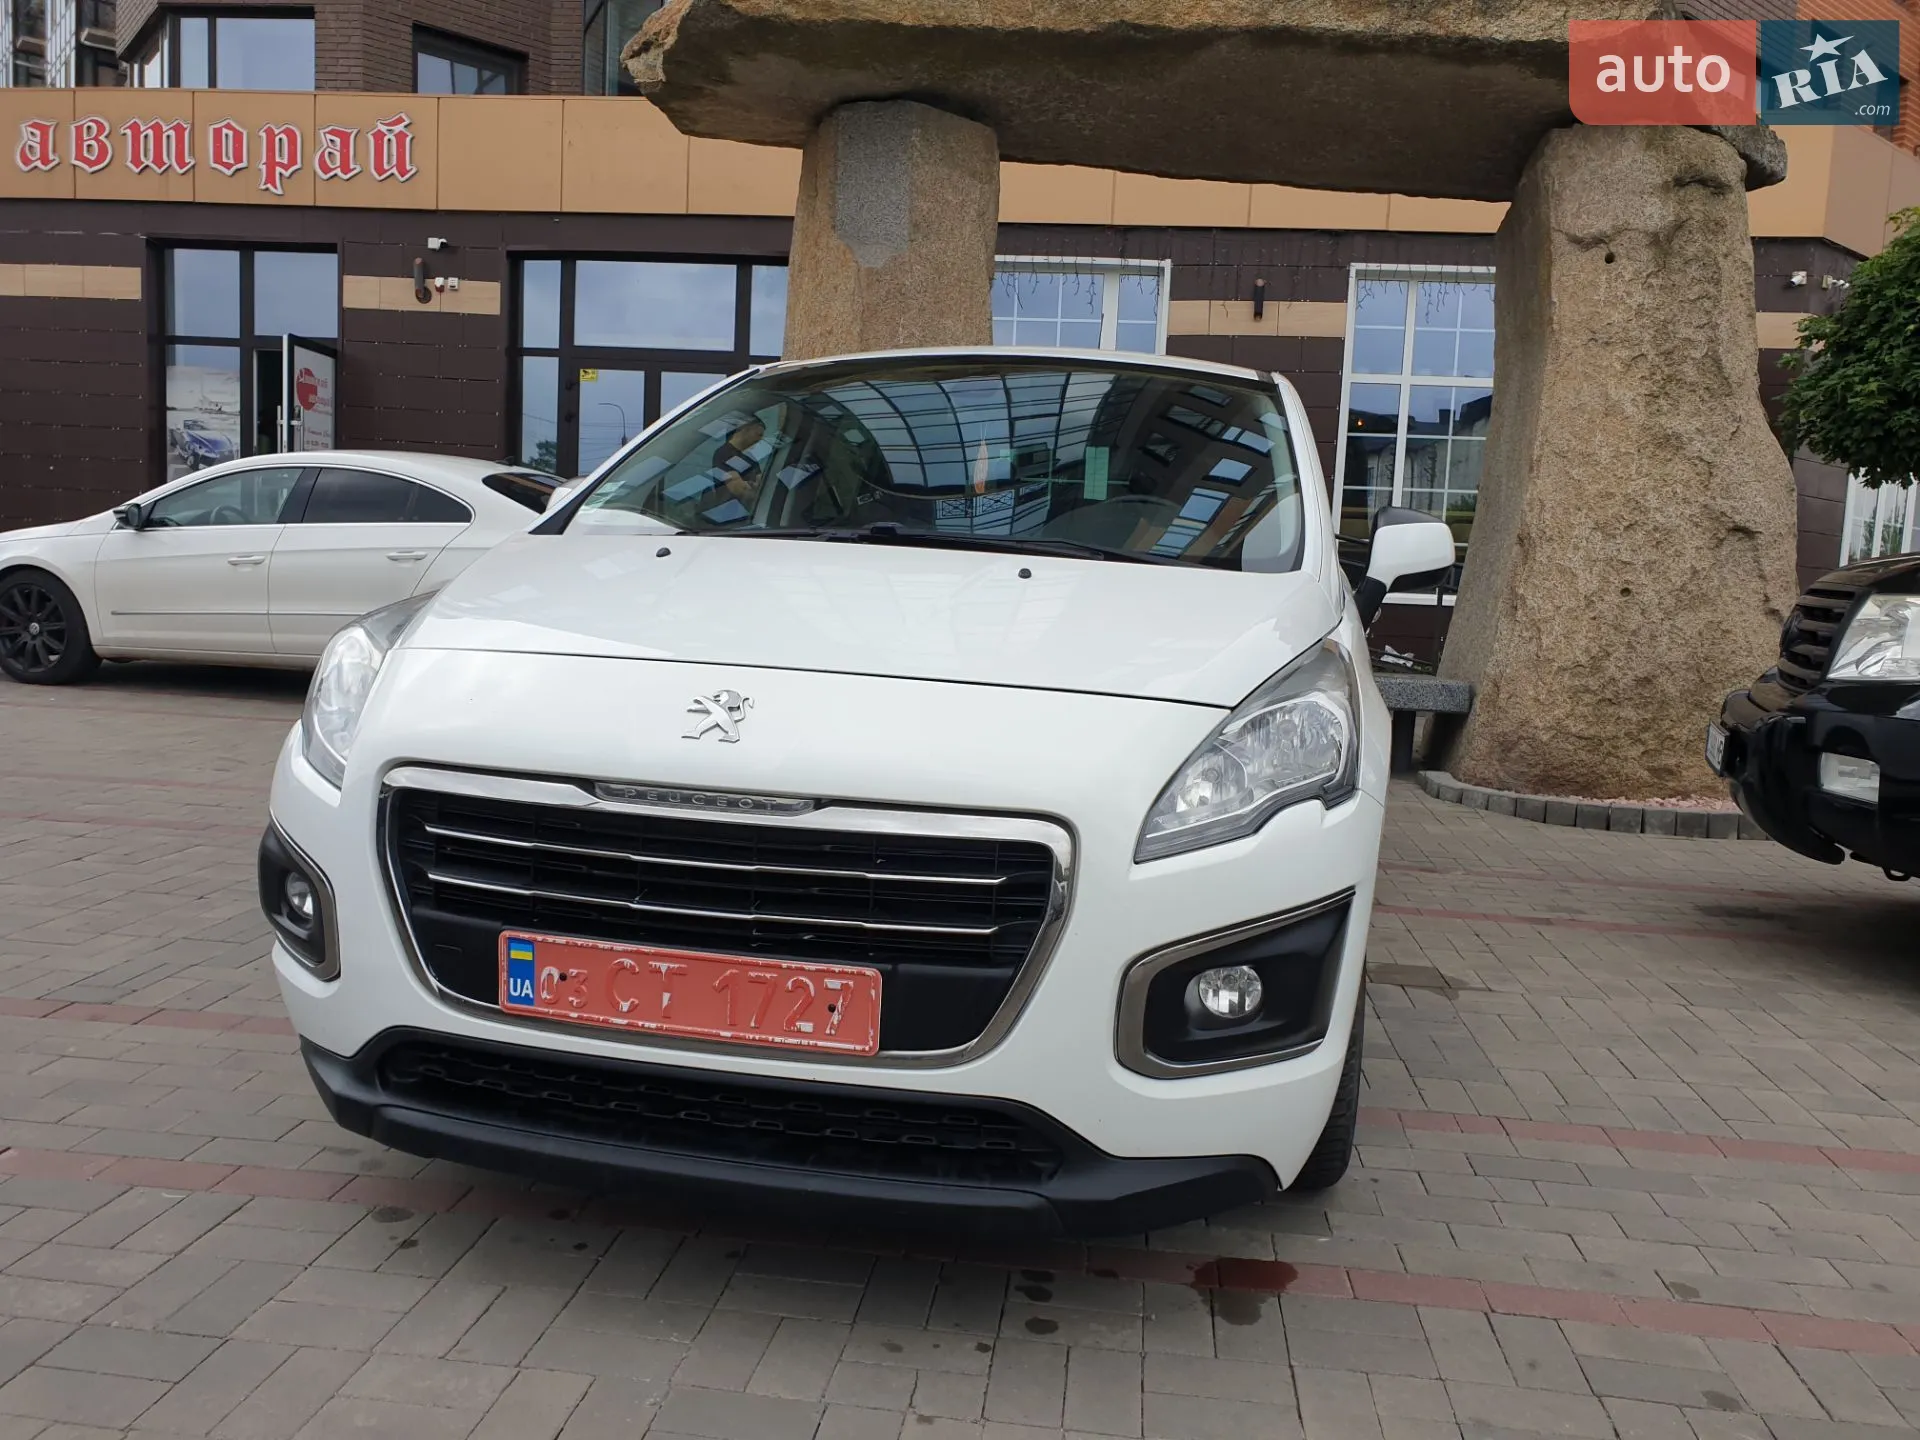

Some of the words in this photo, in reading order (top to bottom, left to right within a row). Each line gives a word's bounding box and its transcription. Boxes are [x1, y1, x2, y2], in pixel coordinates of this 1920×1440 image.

[15, 111, 419, 195] авторай
[623, 788, 778, 812] PEUGEOT
[509, 976, 534, 999] UA
[539, 965, 589, 1009] 03
[607, 957, 689, 1020] CT
[712, 968, 856, 1037] 1727
